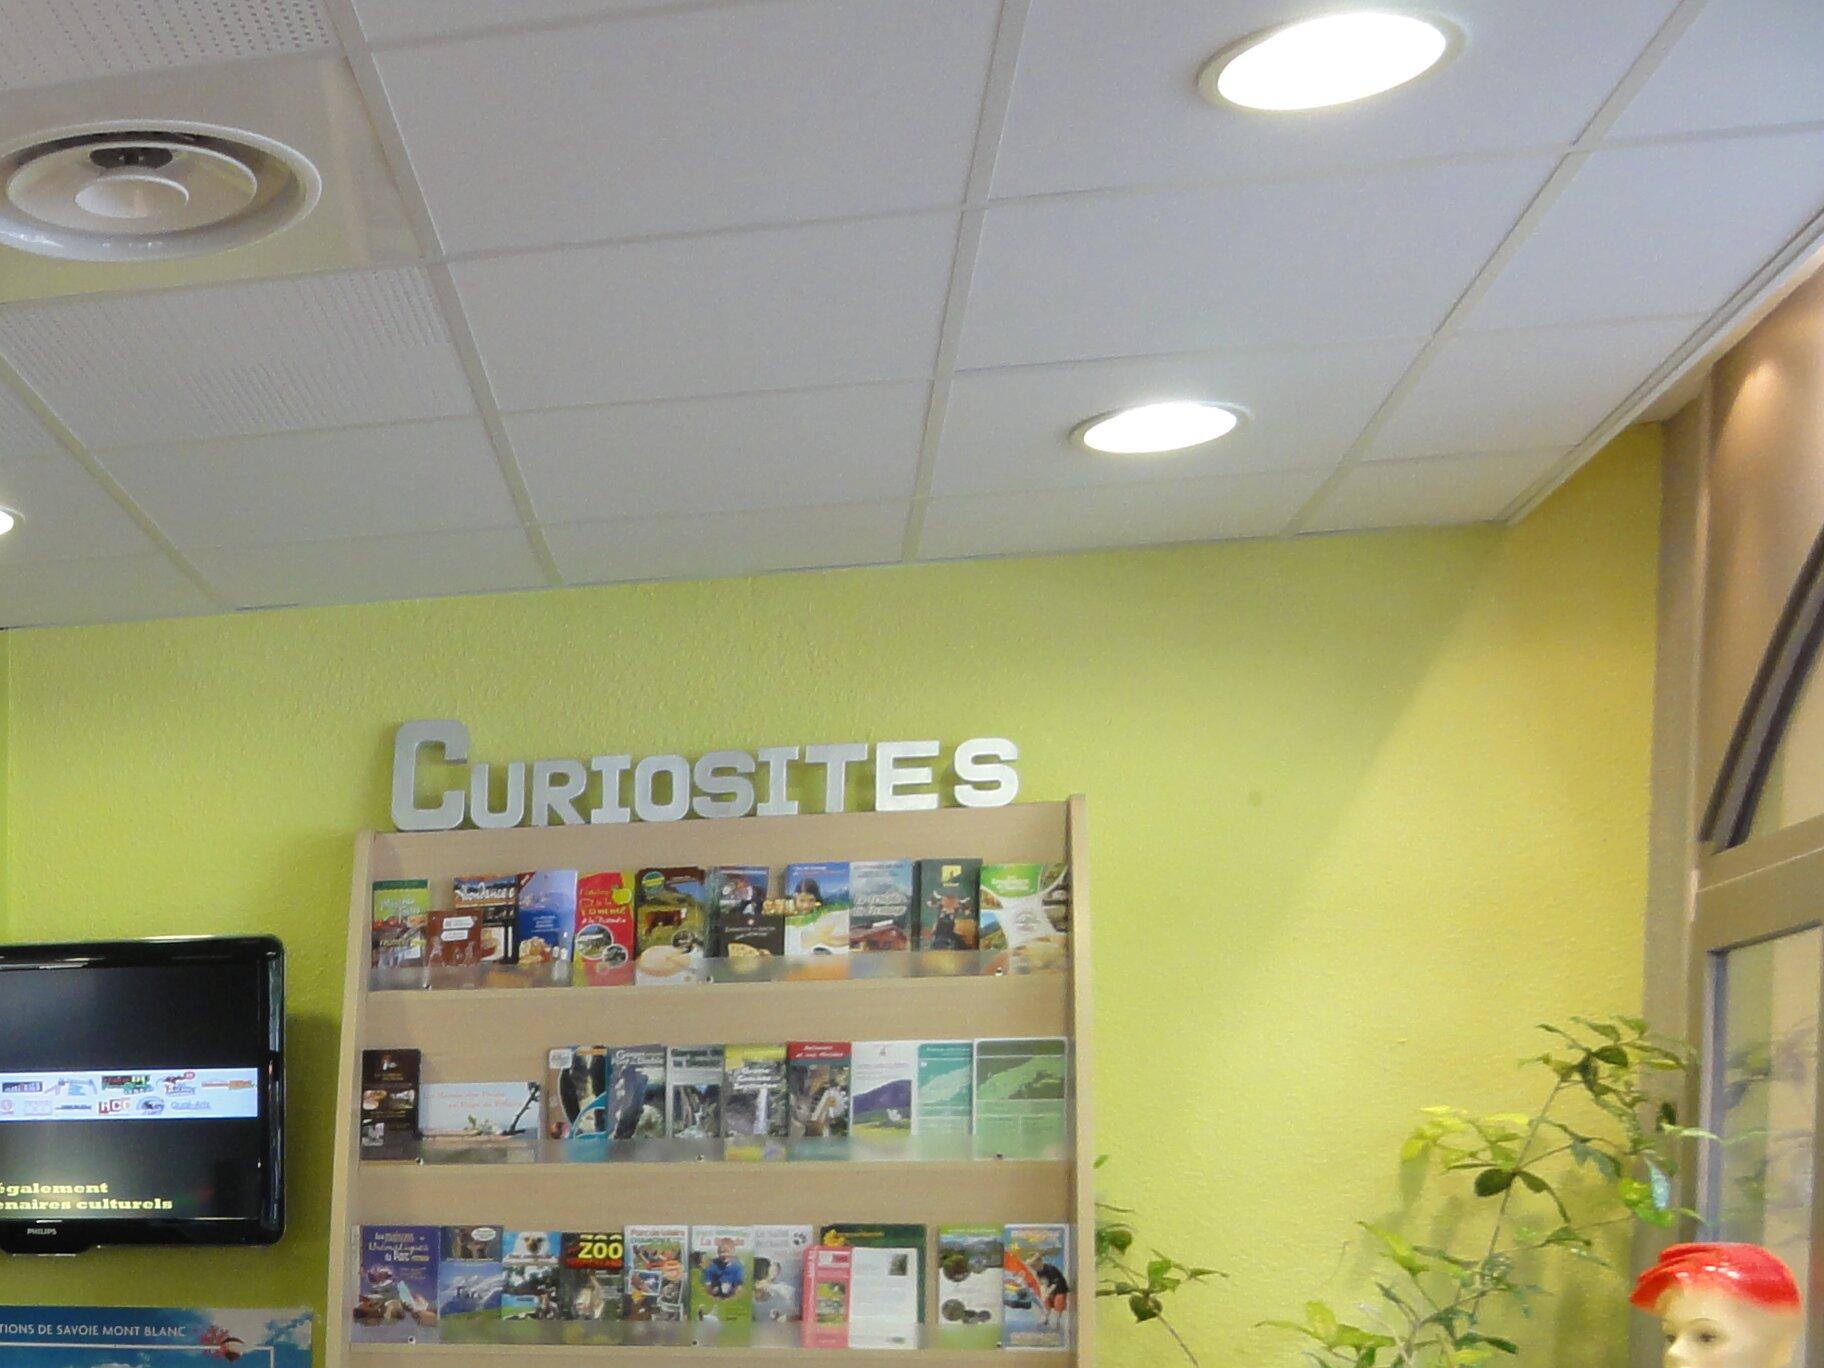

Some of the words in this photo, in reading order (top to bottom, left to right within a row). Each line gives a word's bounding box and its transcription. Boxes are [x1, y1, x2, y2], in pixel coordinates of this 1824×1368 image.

[391, 719, 1019, 831] CURIOSITES
[77, 1198, 173, 1210] culturels
[27, 1228, 57, 1236] PHILIPS
[578, 1242, 623, 1259] ZOO
[38, 1325, 53, 1335] DE
[56, 1325, 99, 1336] SAVOIE
[102, 1326, 140, 1337] MONT
[144, 1326, 186, 1337] BLANC
